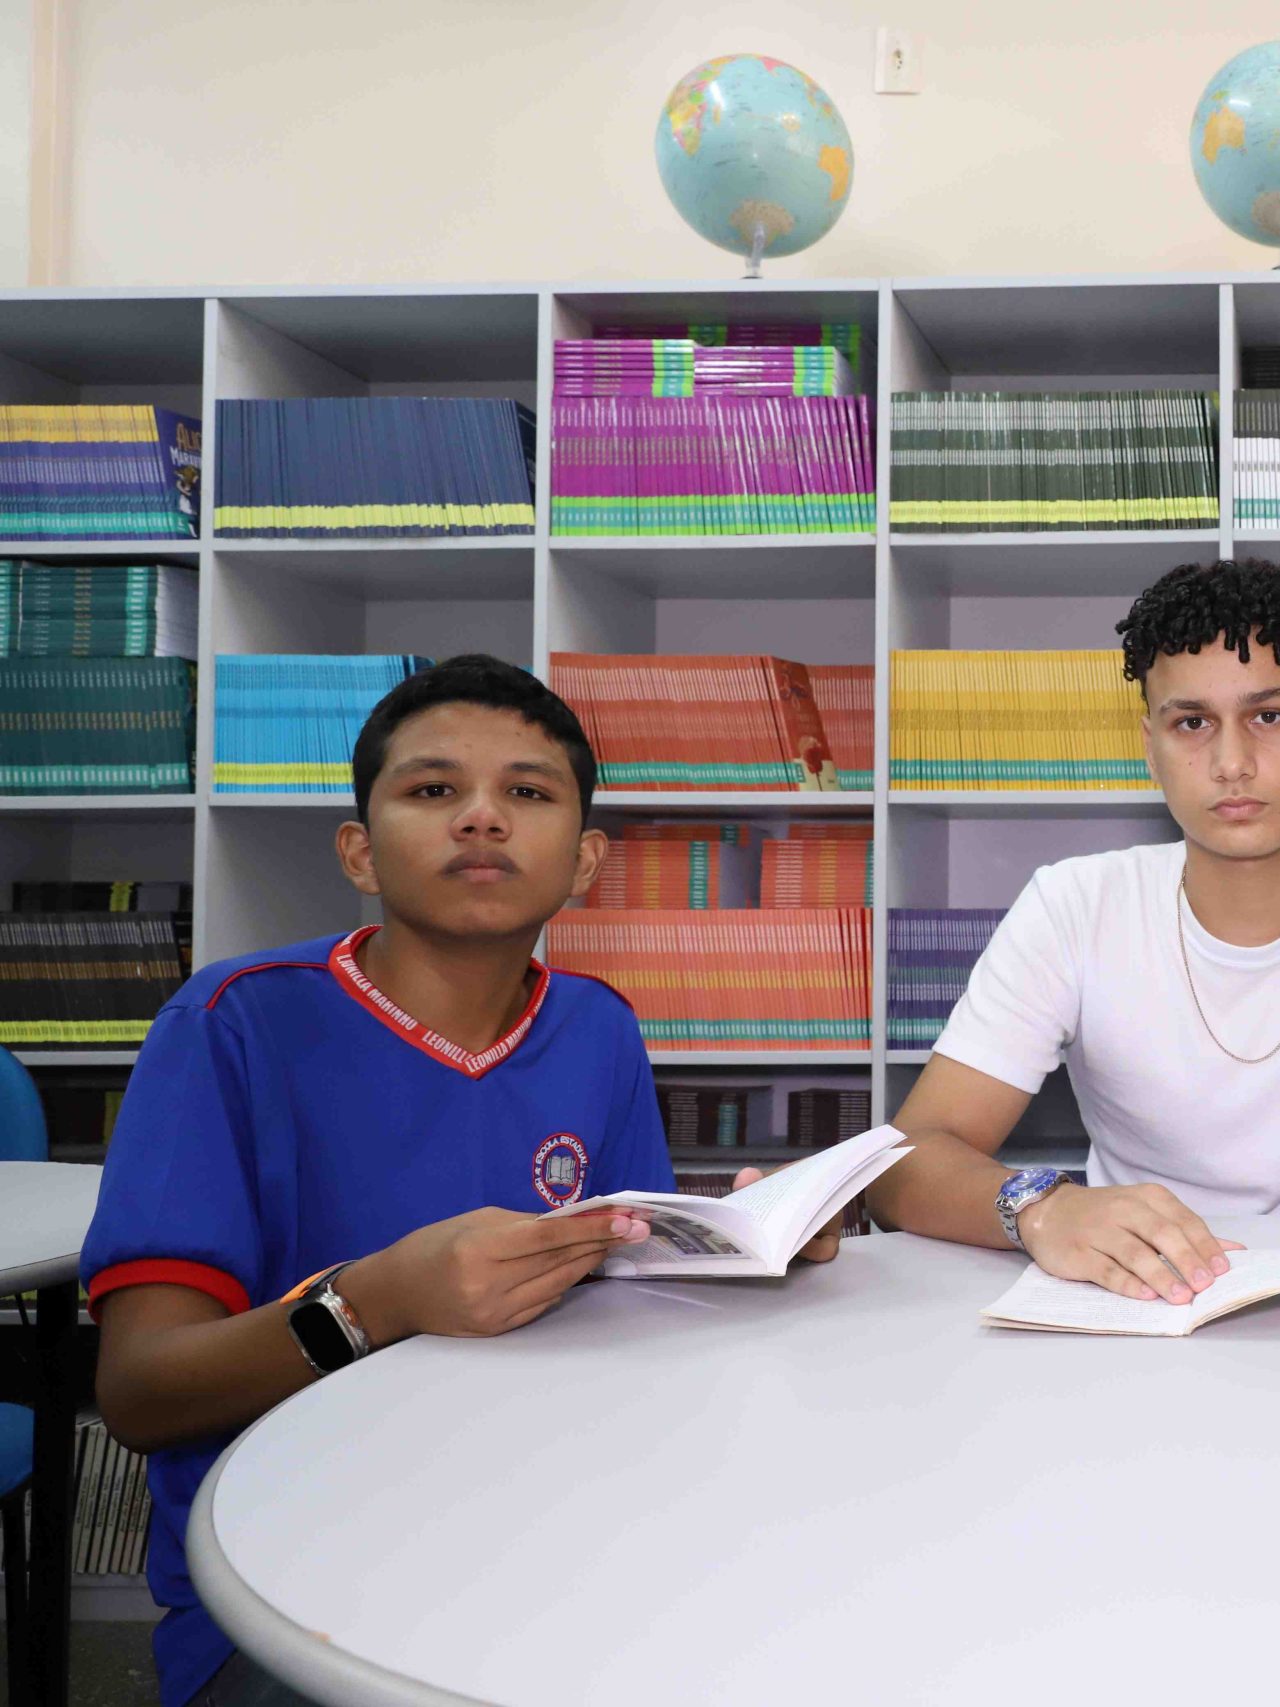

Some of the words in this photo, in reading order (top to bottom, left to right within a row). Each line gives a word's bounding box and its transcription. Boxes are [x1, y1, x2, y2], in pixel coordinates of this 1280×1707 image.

[368, 986, 418, 1031] MARINHO
[464, 1042, 508, 1073] LEONILLA
[536, 1138, 559, 1164] ESCOLA
[560, 1136, 588, 1164] ESTADUAL
